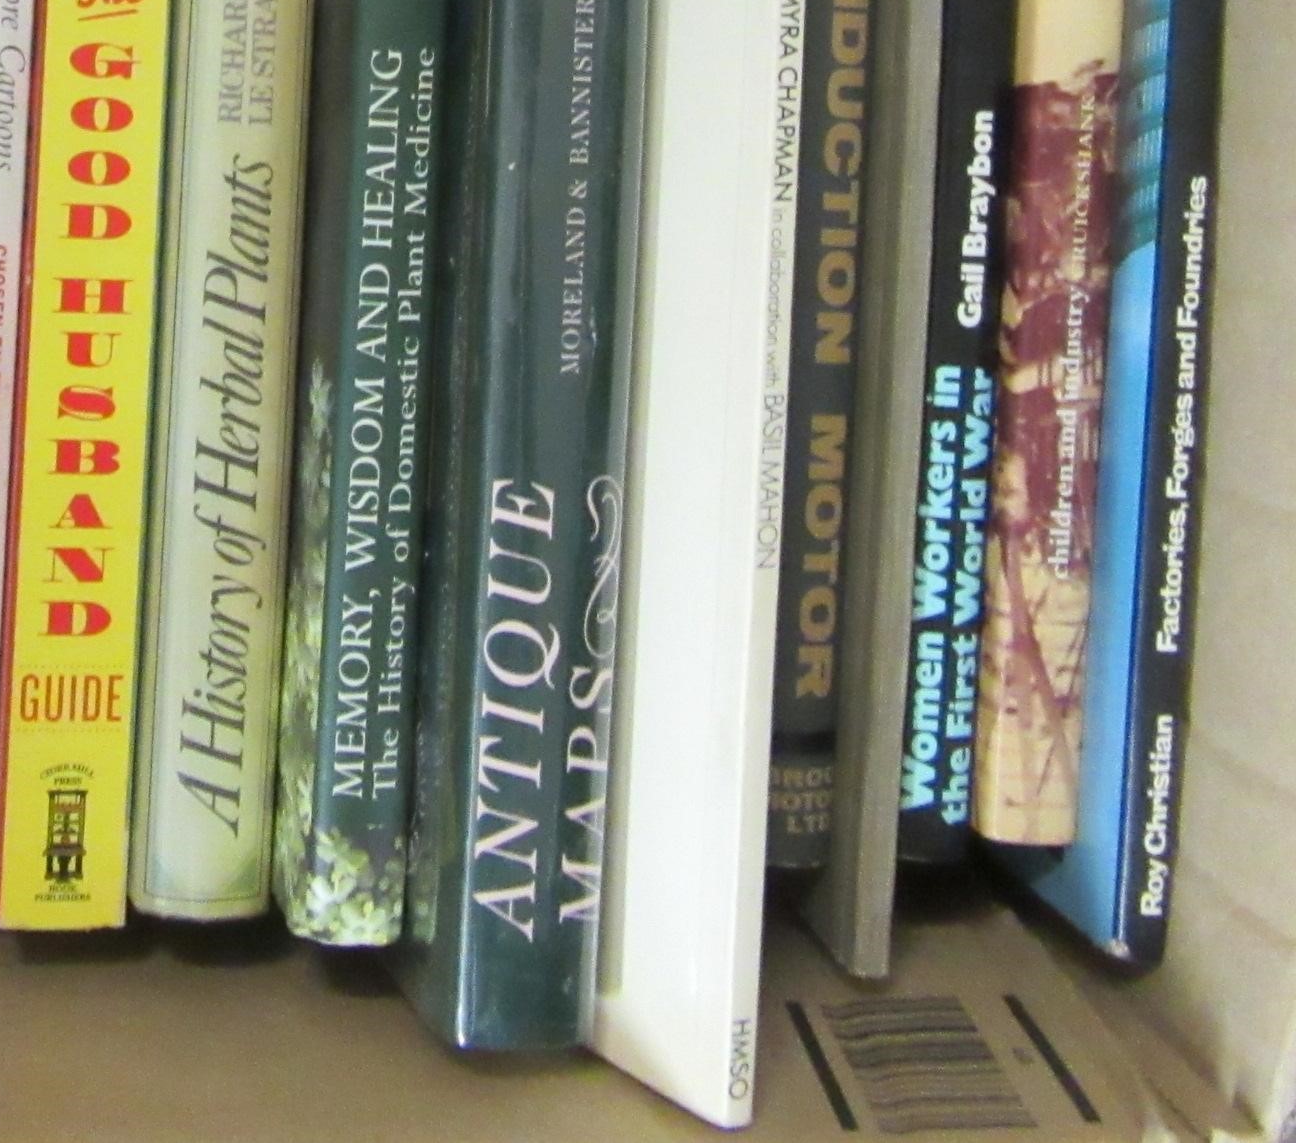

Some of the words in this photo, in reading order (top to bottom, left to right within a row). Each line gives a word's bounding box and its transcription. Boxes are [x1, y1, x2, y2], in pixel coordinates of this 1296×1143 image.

[60, 42, 141, 241] GOOD
[362, 48, 402, 249] HEALING
[405, 47, 435, 216] Medicine
[571, 180, 588, 199] &
[774, 66, 798, 204] CHAPMAN
[962, 110, 996, 257] Braybon
[1069, 94, 1095, 280] CRUICKSHANK
[203, 154, 273, 326] Plants
[772, 206, 786, 222] in
[1177, 176, 1208, 326] Foundries
[355, 263, 391, 361] AND
[397, 230, 425, 323] Plant
[560, 207, 587, 376] MORELAND
[768, 225, 784, 346] collaboration
[957, 264, 985, 328] Gail
[765, 350, 780, 389] with
[927, 365, 961, 407] in
[1058, 285, 1088, 401] industry
[1176, 331, 1197, 381] and
[38, 277, 133, 636] HUSBAND
[193, 316, 264, 512] Herbal
[345, 377, 385, 571] WISDOM
[389, 335, 421, 513] Domestic
[763, 394, 785, 464] BASIL
[963, 367, 995, 469] War
[1055, 409, 1077, 460] and
[1166, 385, 1195, 498] Forges
[194, 505, 266, 567] of
[384, 525, 410, 561] of
[757, 465, 781, 569] MAHON
[795, 414, 847, 698] MOTOR
[912, 420, 956, 621] Workers
[954, 478, 988, 626] World
[1049, 466, 1076, 580] children
[1156, 502, 1191, 653] Factories,
[20, 674, 124, 722] GUIDE
[179, 577, 261, 770] History
[332, 589, 381, 798] MEMORY,
[377, 576, 416, 714] History
[947, 632, 977, 737] First
[371, 729, 399, 801] The
[473, 477, 560, 944] ANTIQUE
[901, 632, 944, 810] Women
[177, 761, 241, 838] A
[560, 665, 612, 925] MAPS
[942, 747, 971, 825] the
[1144, 714, 1174, 853] Christian
[1140, 856, 1167, 918] Roy
[729, 1018, 752, 1099] HMSO
